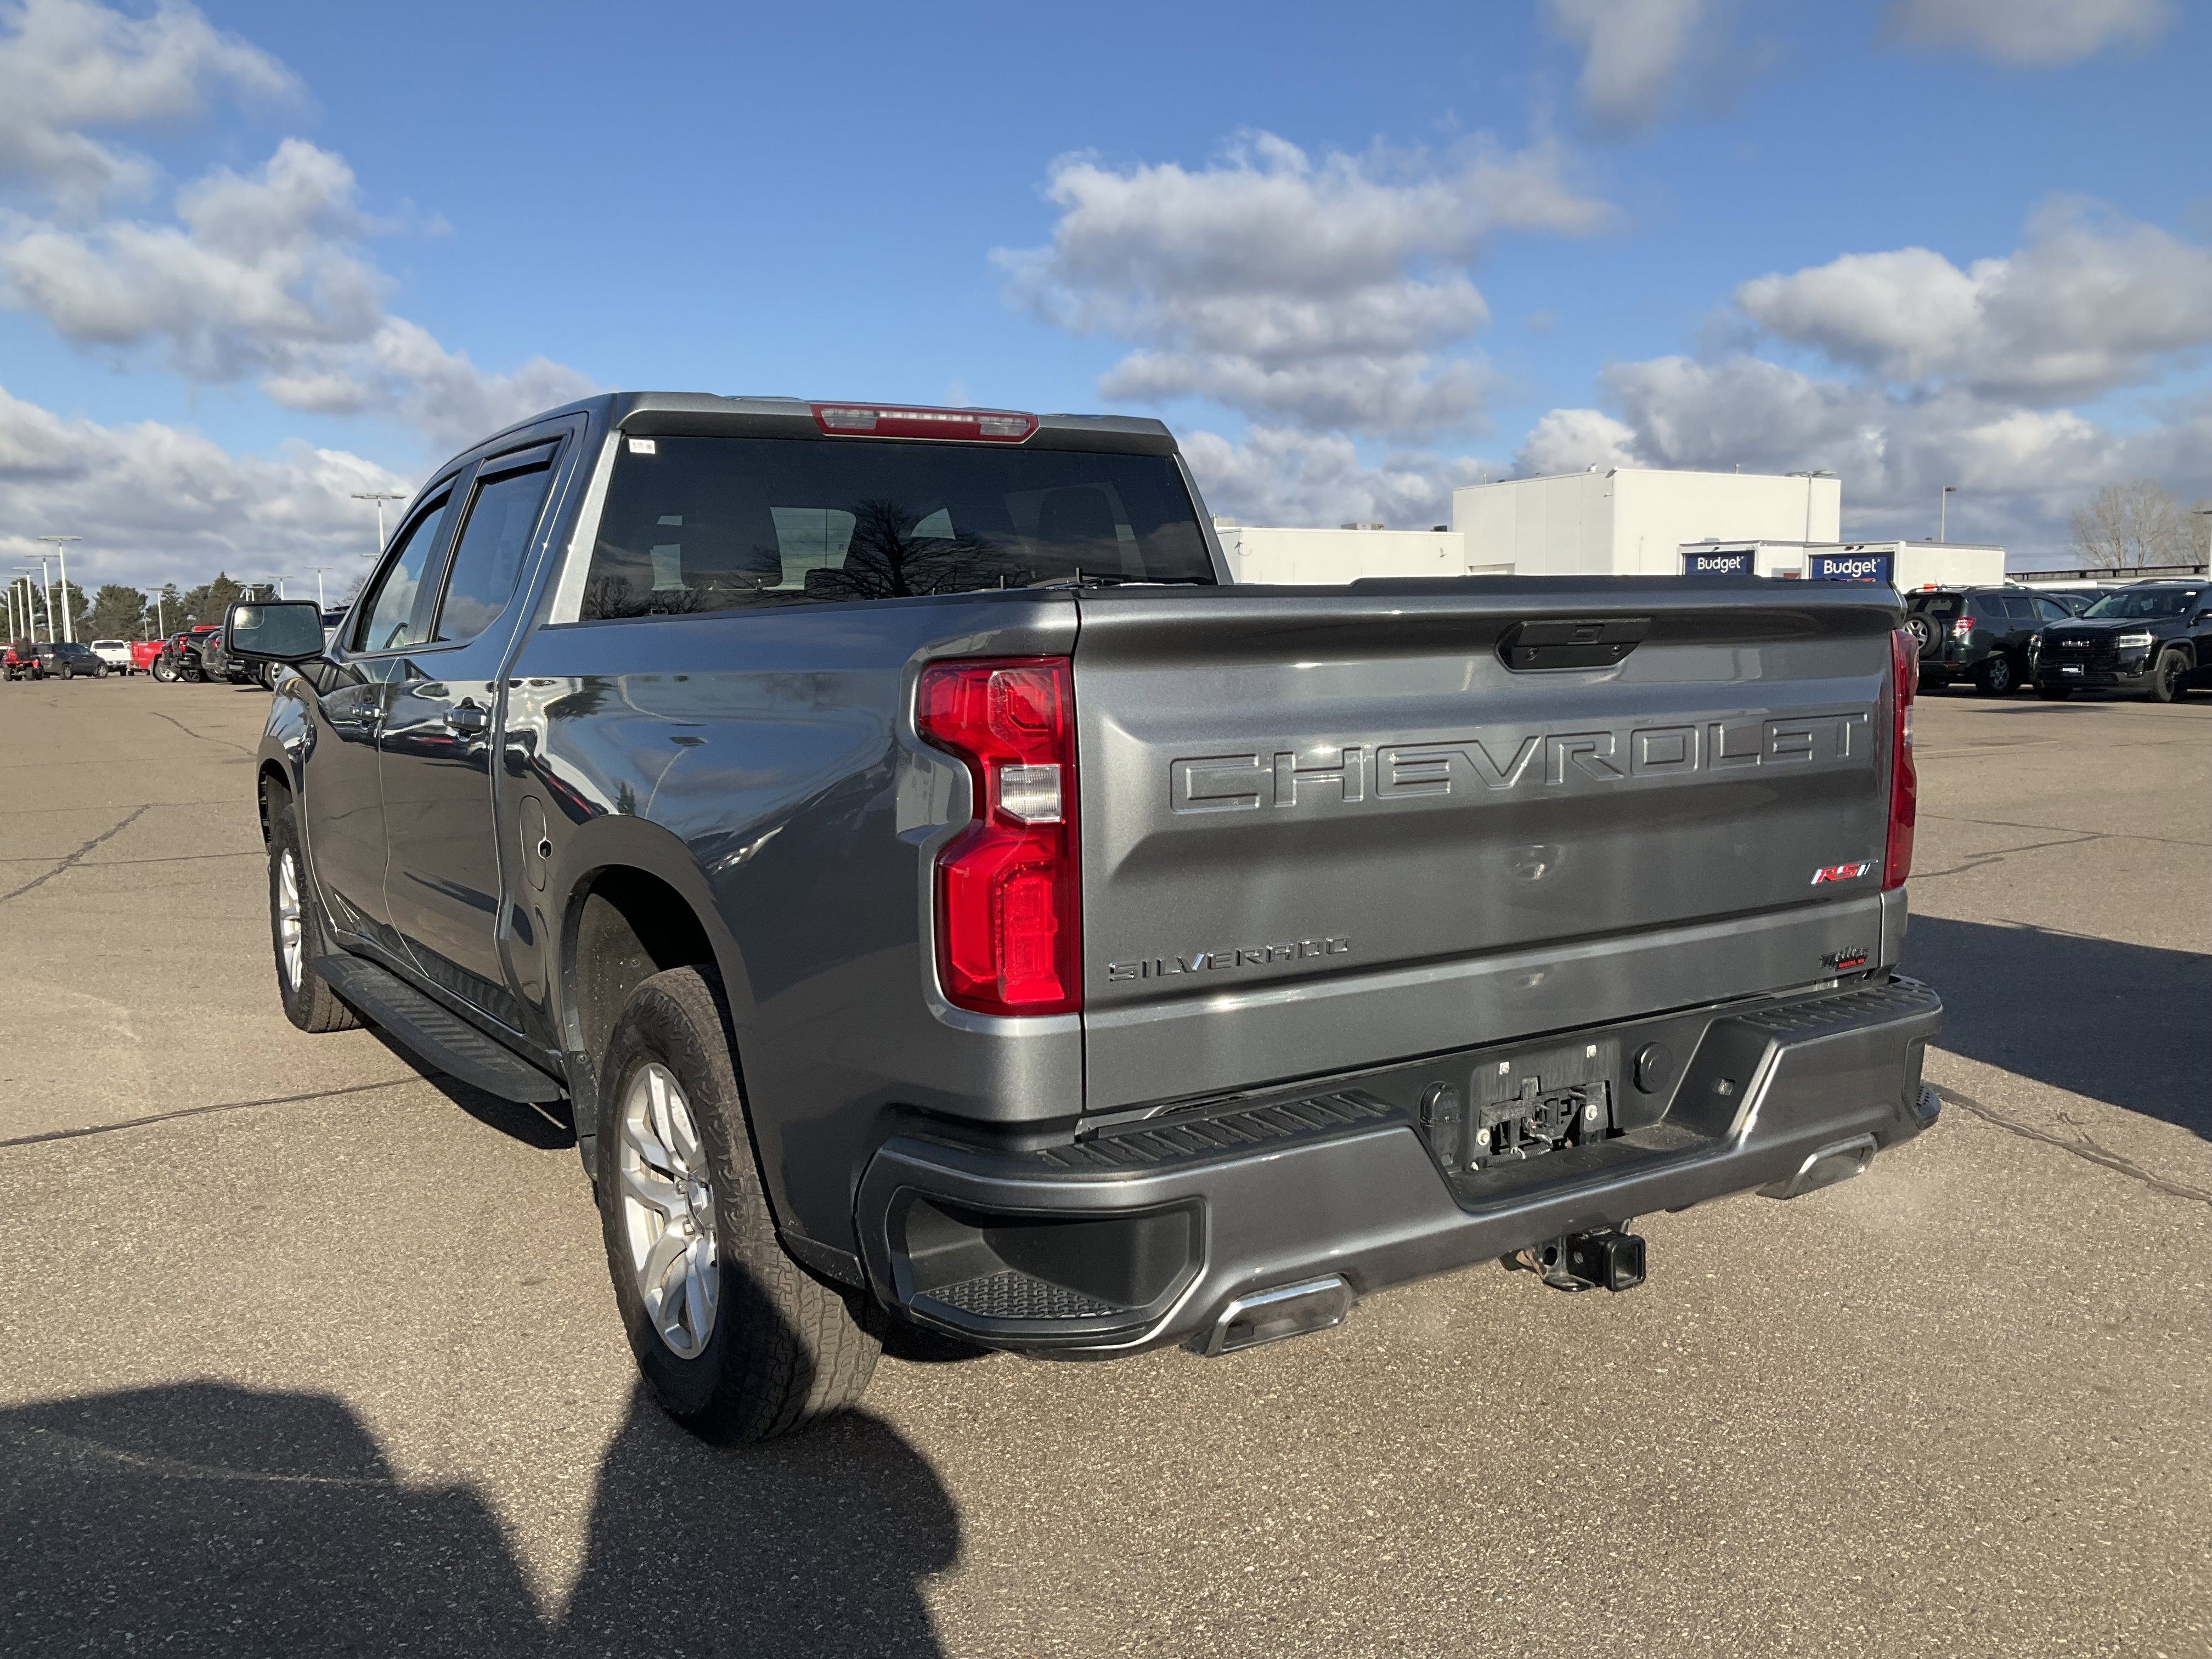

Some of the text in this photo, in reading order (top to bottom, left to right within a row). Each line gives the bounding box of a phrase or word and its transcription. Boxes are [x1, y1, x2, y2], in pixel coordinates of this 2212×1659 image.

[1697, 556, 1741, 573] Budget
[1824, 558, 1877, 578] Budget
[1170, 712, 1867, 813] CHEVROLET
[1811, 860, 1879, 884] RST
[1109, 935, 1351, 982] SILVERADO
